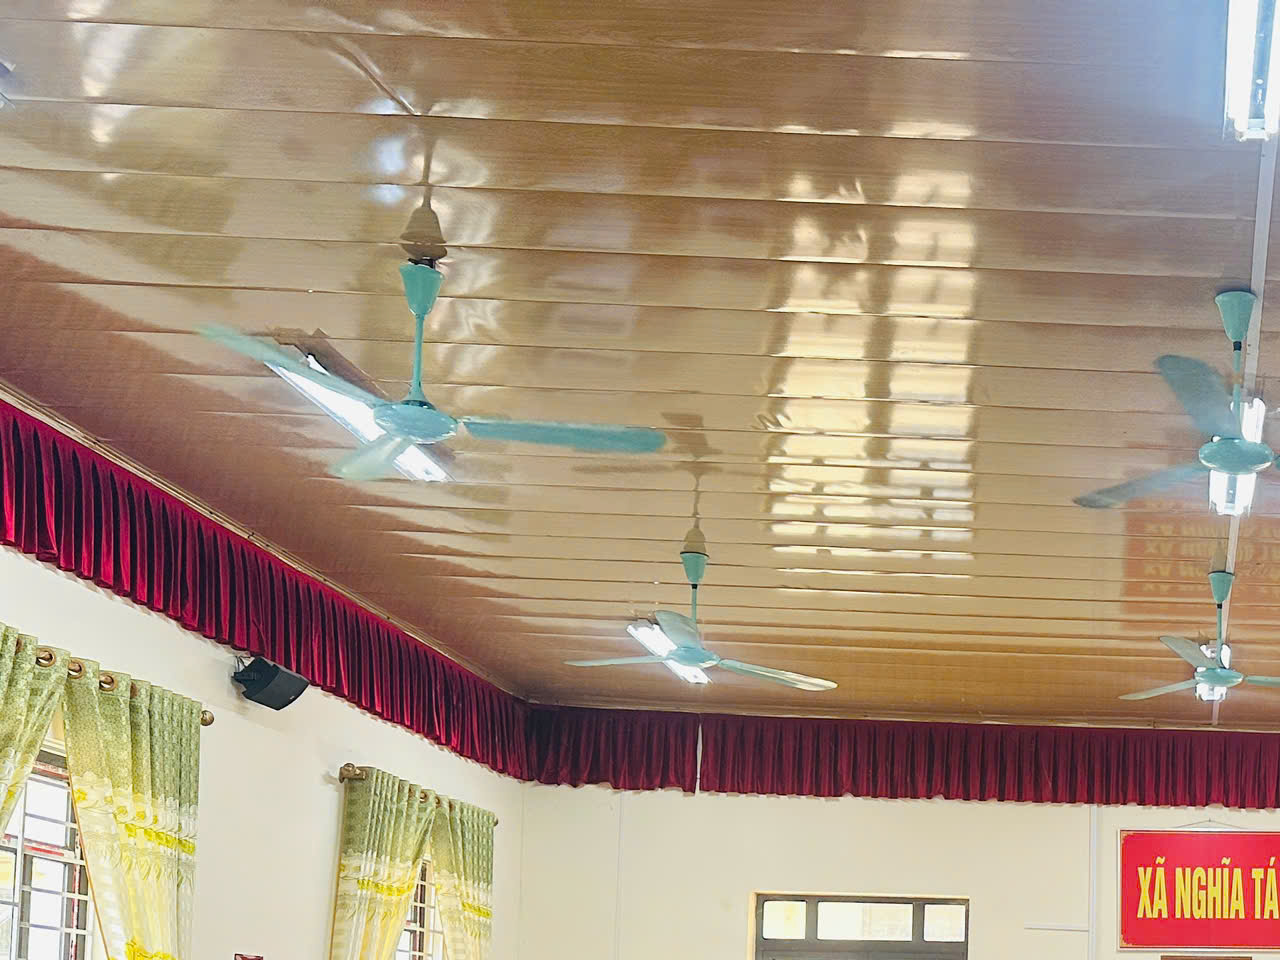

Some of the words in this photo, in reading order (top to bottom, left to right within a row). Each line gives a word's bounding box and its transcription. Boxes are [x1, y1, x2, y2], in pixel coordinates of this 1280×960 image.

[1137, 857, 1168, 918] XÃ
[1175, 857, 1245, 919] NGHĨA
[1252, 857, 1279, 919] TÁ
